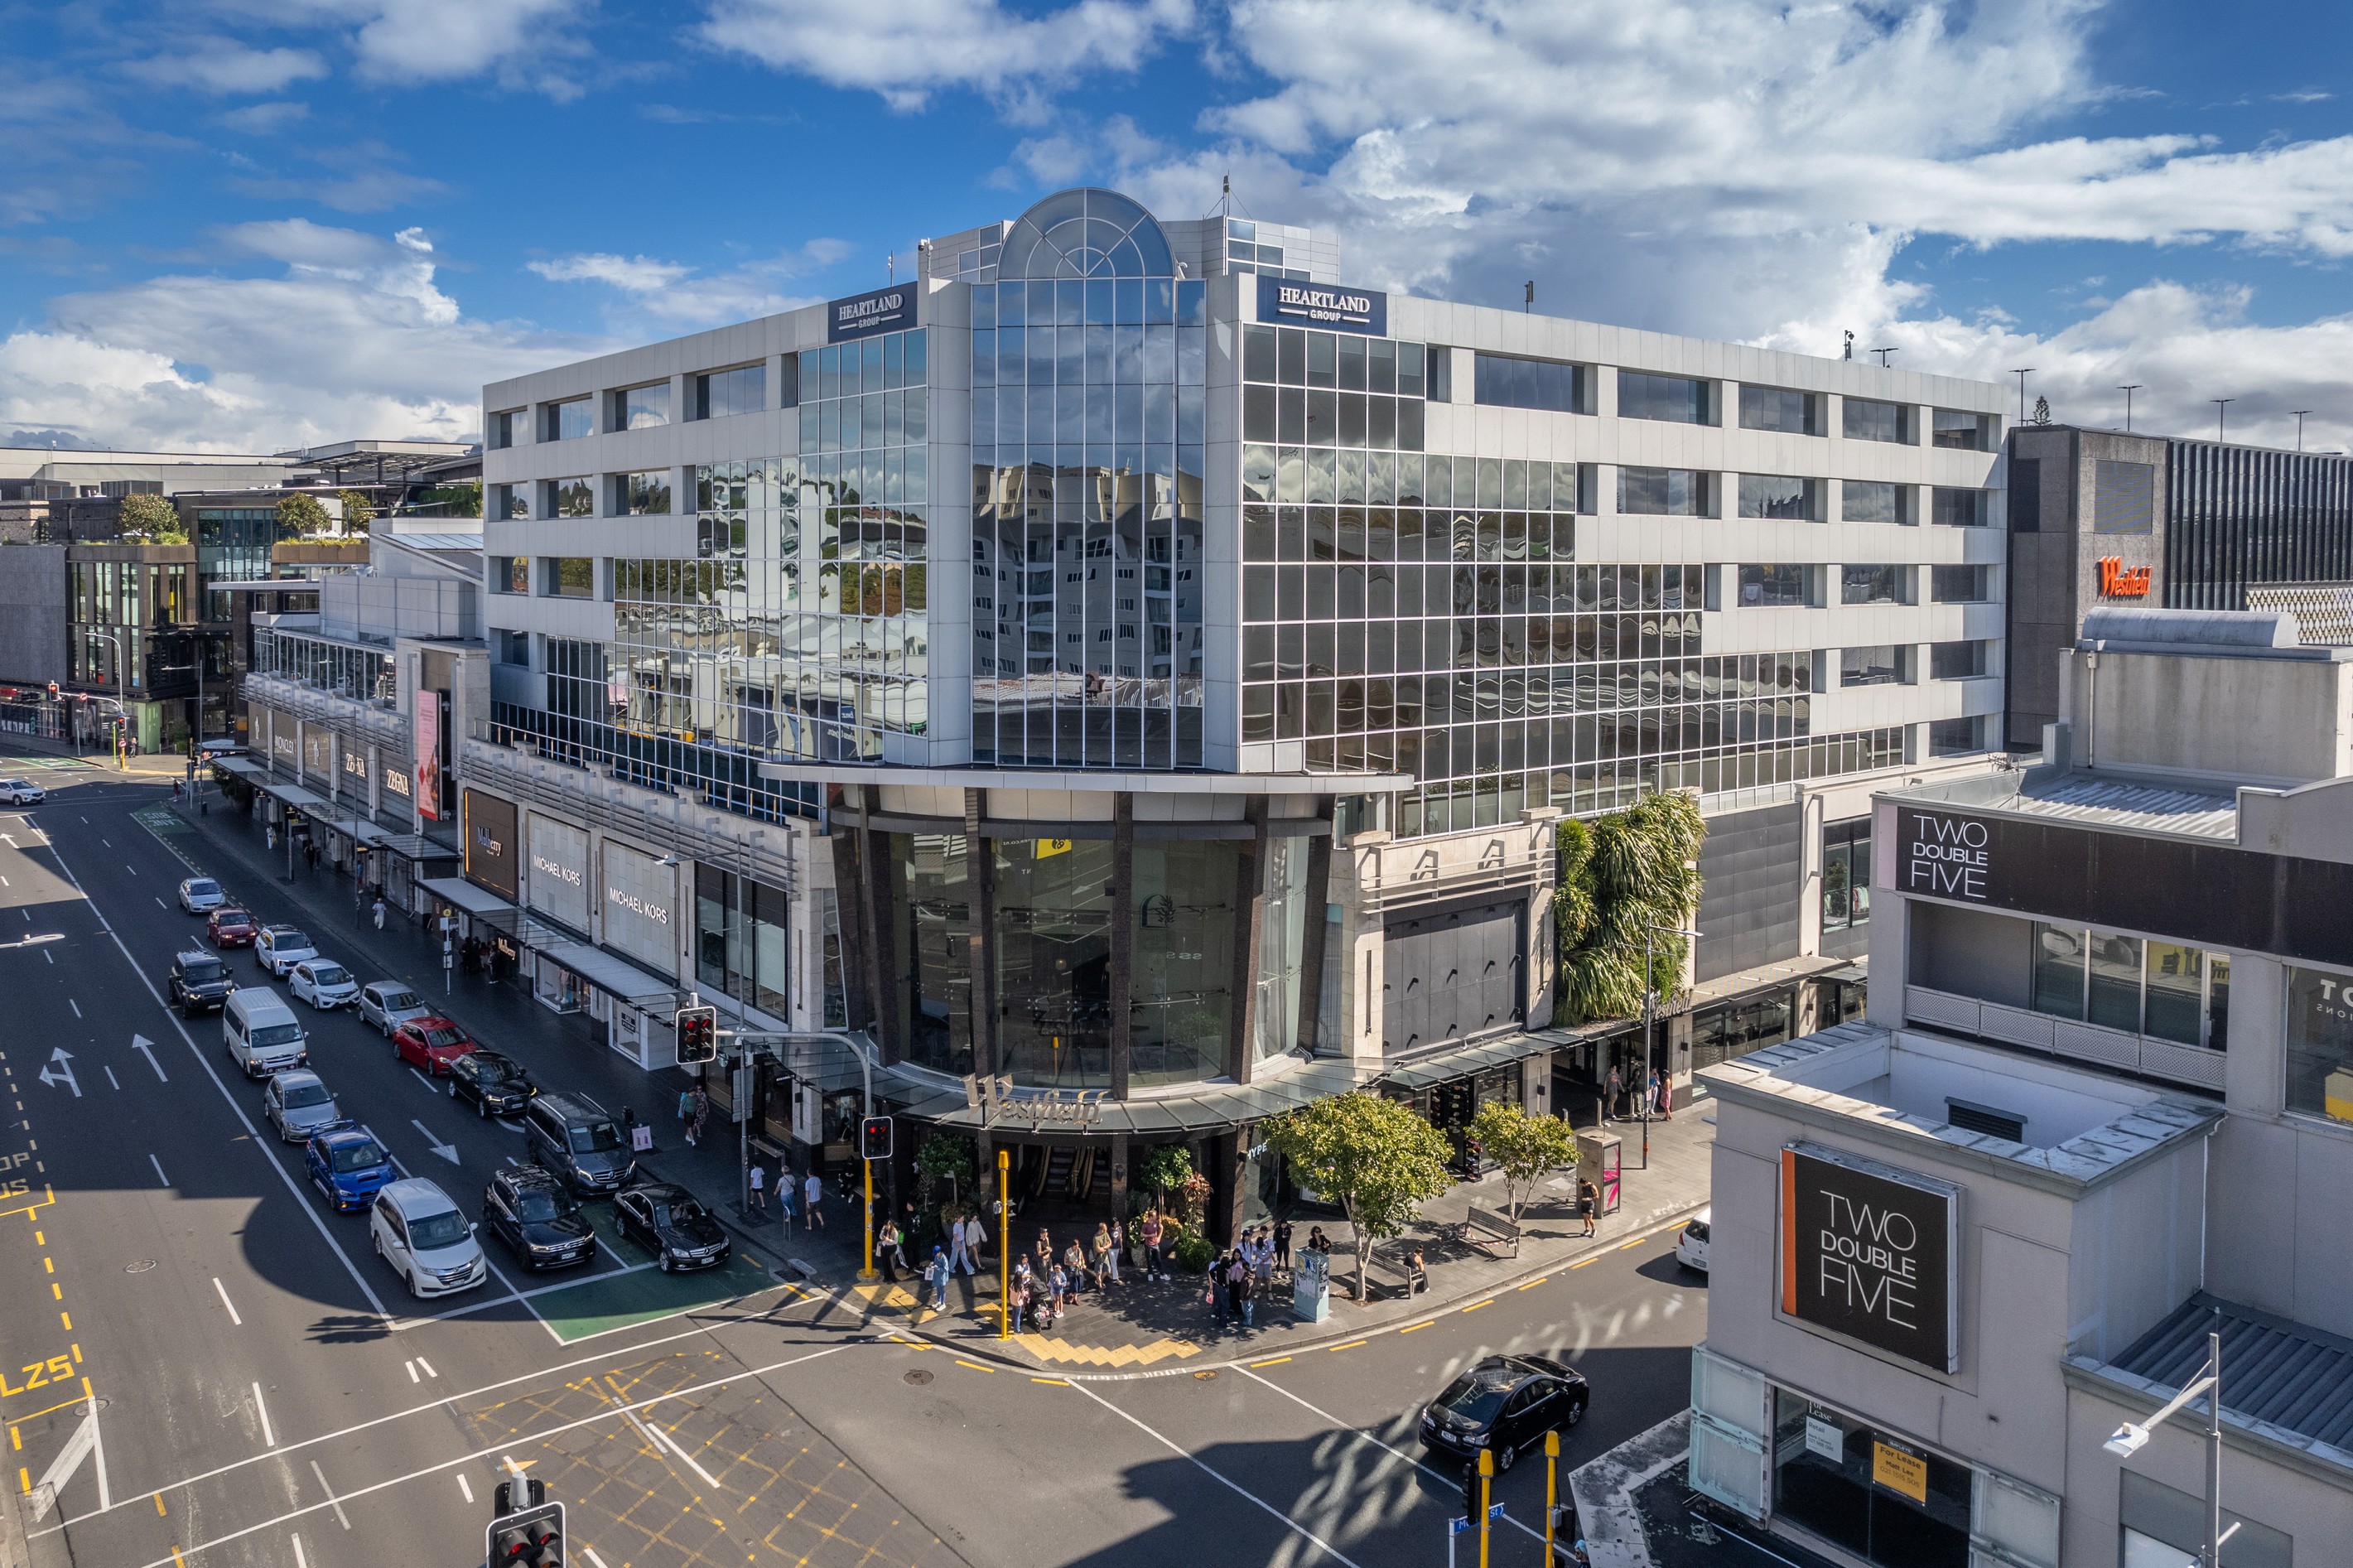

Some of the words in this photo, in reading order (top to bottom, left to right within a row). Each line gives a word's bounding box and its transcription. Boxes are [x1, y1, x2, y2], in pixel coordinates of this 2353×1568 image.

[838, 294, 904, 321] HEARTLAND
[1279, 287, 1371, 313] HEARTLAND
[858, 316, 880, 328] GROUP
[1310, 310, 1341, 321] GROUP
[2099, 556, 2153, 596] Westfield
[274, 736, 295, 755] MONCLER
[387, 769, 410, 796] ZEGNA
[1912, 815, 1988, 847] TWO
[1912, 842, 1989, 866] DOUBLE
[533, 854, 562, 878] MICHAEL
[562, 866, 581, 887] KORS
[1912, 860, 1987, 899] FIVE
[610, 887, 643, 914] MICHAEL
[644, 901, 668, 924] KORS
[958, 1073, 1109, 1131] Westfield
[1820, 1189, 1917, 1251] TWO
[1821, 1230, 1917, 1280] DOUBLE
[1821, 1254, 1917, 1330] FIVE
[1808, 1421, 1825, 1433] Retail
[1809, 1406, 1832, 1422] Lease
[1880, 1446, 1895, 1457] For
[1897, 1453, 1921, 1469] Lease
[1880, 1465, 1892, 1475] 021
[1885, 1460, 1900, 1471] Matt
[1902, 1467, 1914, 1477] Lee
[1490, 1508, 1499, 1518] St
